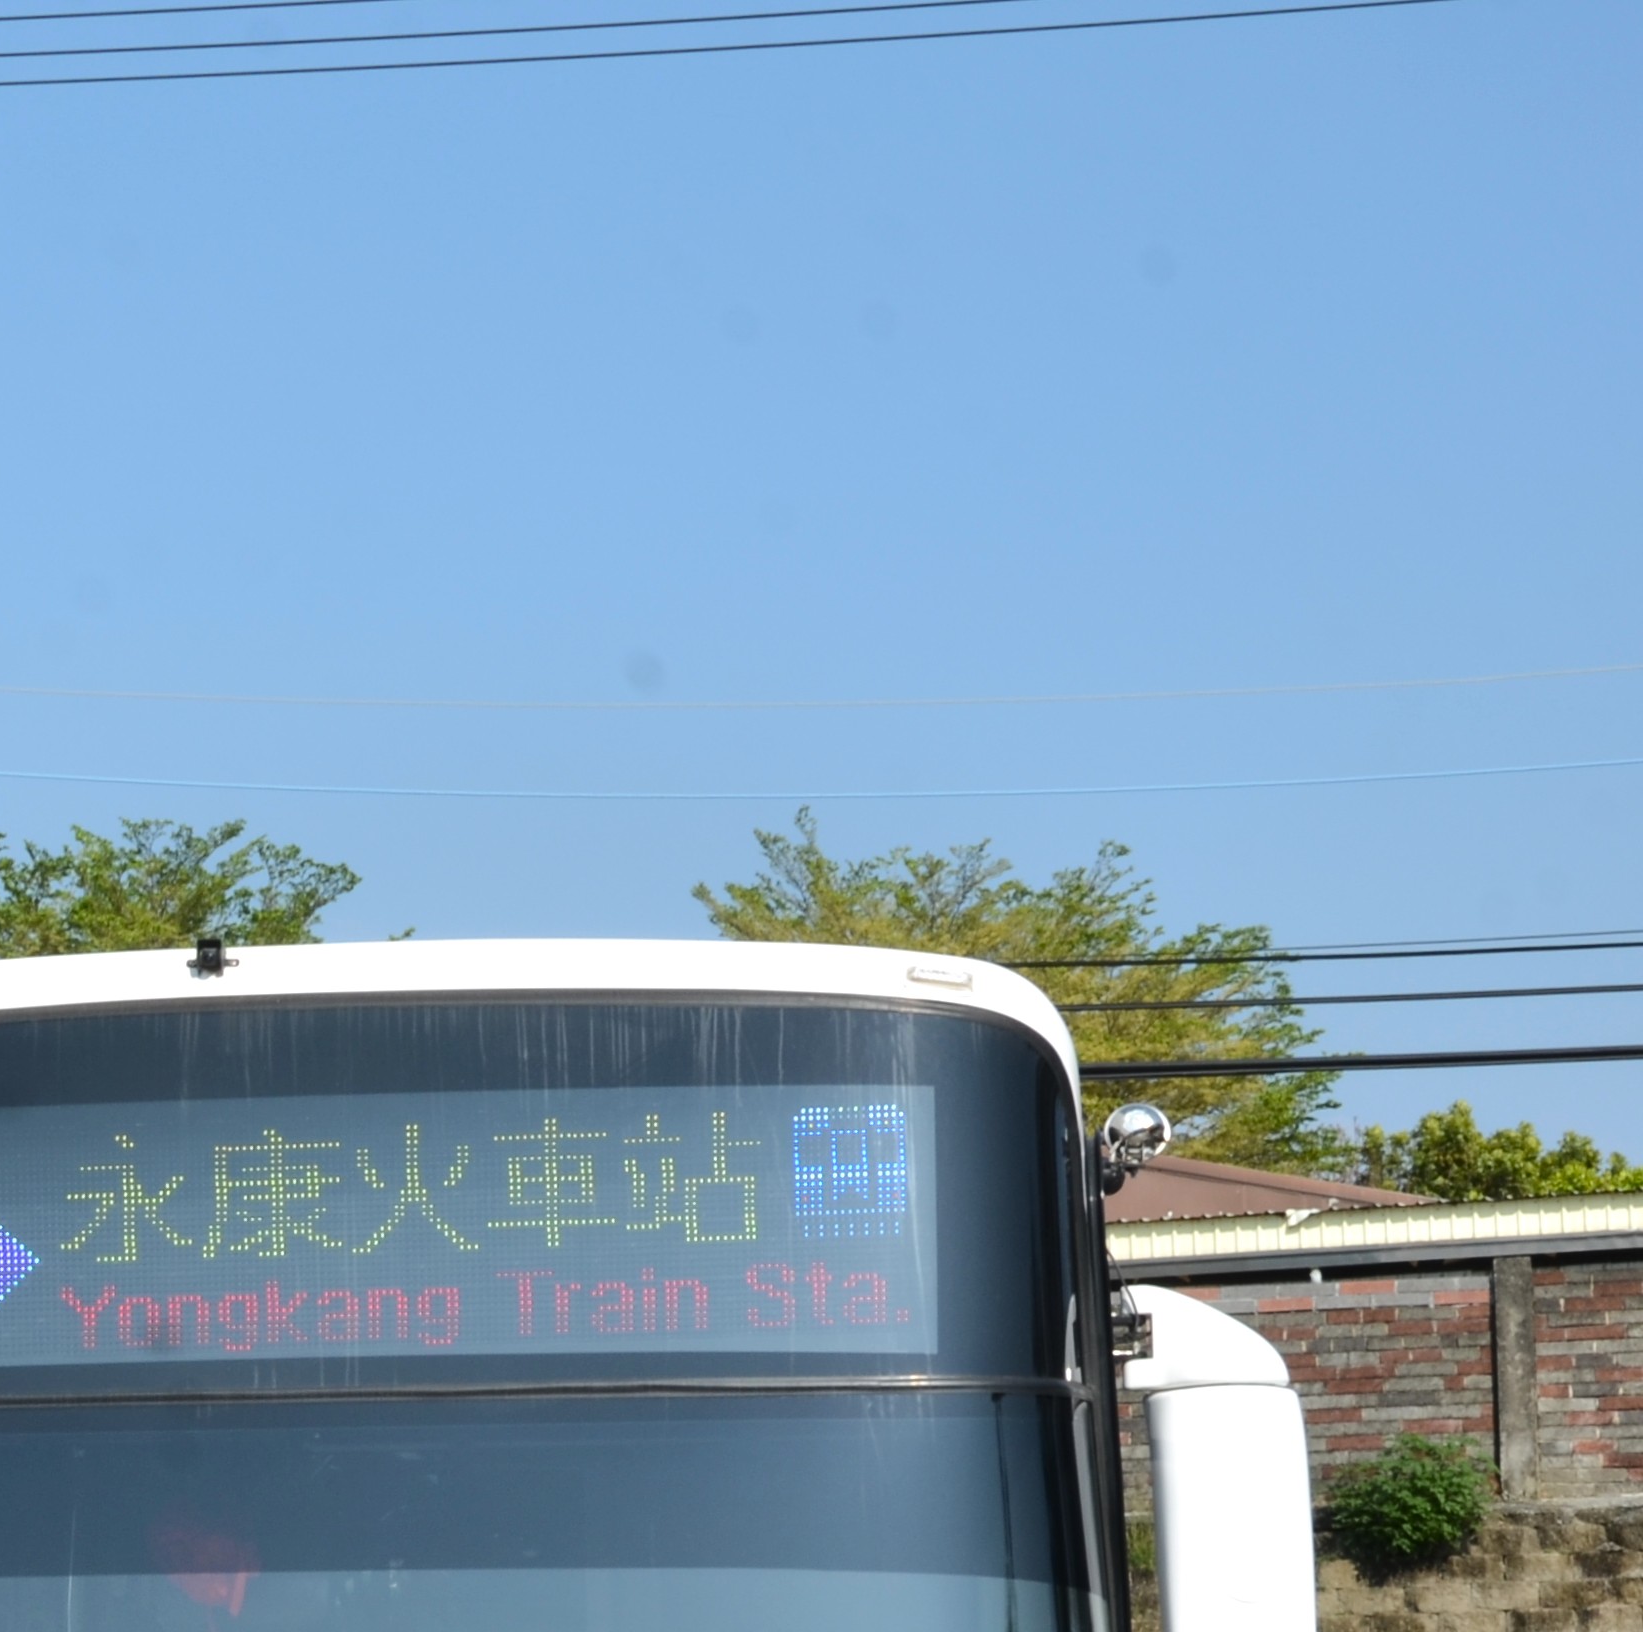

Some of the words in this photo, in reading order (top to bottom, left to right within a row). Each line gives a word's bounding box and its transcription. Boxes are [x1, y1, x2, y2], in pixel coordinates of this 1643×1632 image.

[61, 1110, 761, 1264] 永康火車站
[61, 1282, 461, 1352] Yongkang
[498, 1268, 710, 1338] Train
[745, 1260, 910, 1328] Sta.
